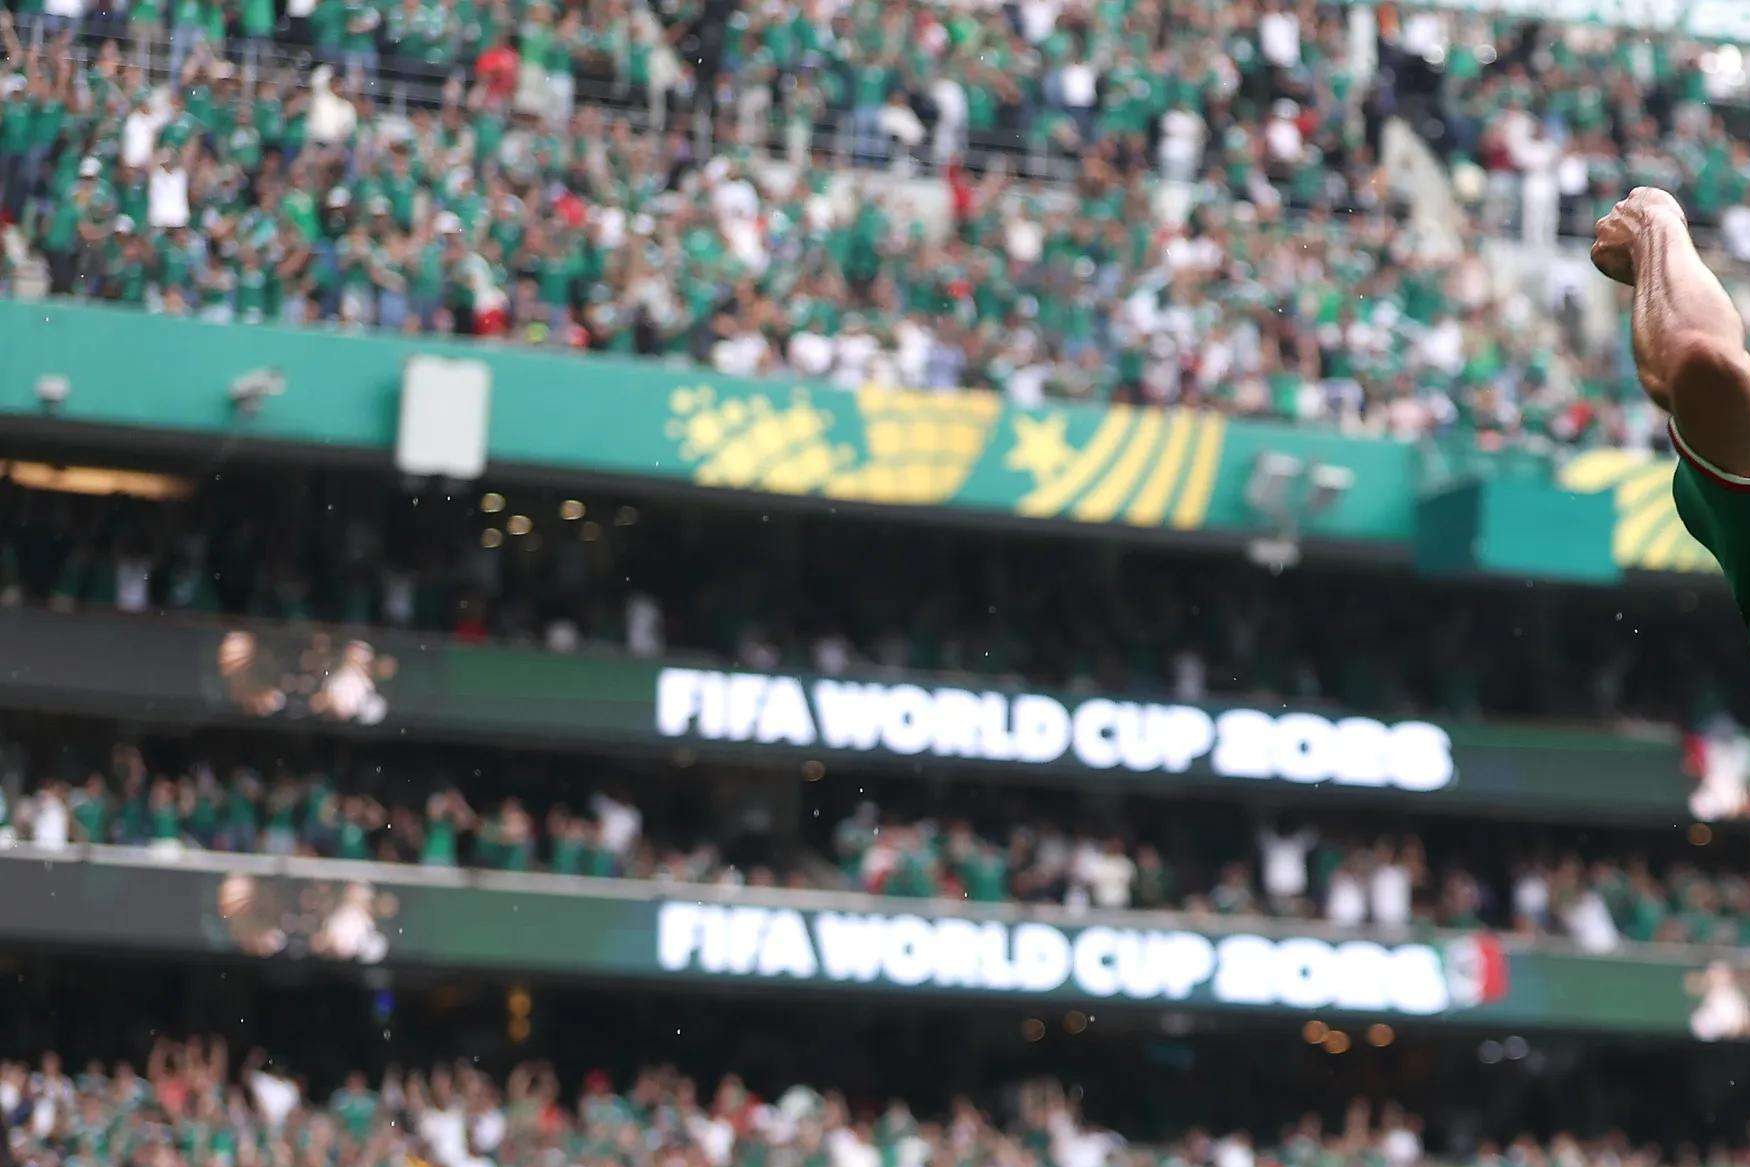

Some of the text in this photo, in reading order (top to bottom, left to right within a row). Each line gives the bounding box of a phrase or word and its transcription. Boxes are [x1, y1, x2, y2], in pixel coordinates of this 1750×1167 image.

[659, 670, 814, 742] FIFA
[818, 682, 1070, 760] WORLD
[1073, 701, 1214, 769] CUP
[660, 902, 816, 975] FIFA
[818, 912, 1070, 989] WORLD
[1073, 926, 1214, 996] CUP
